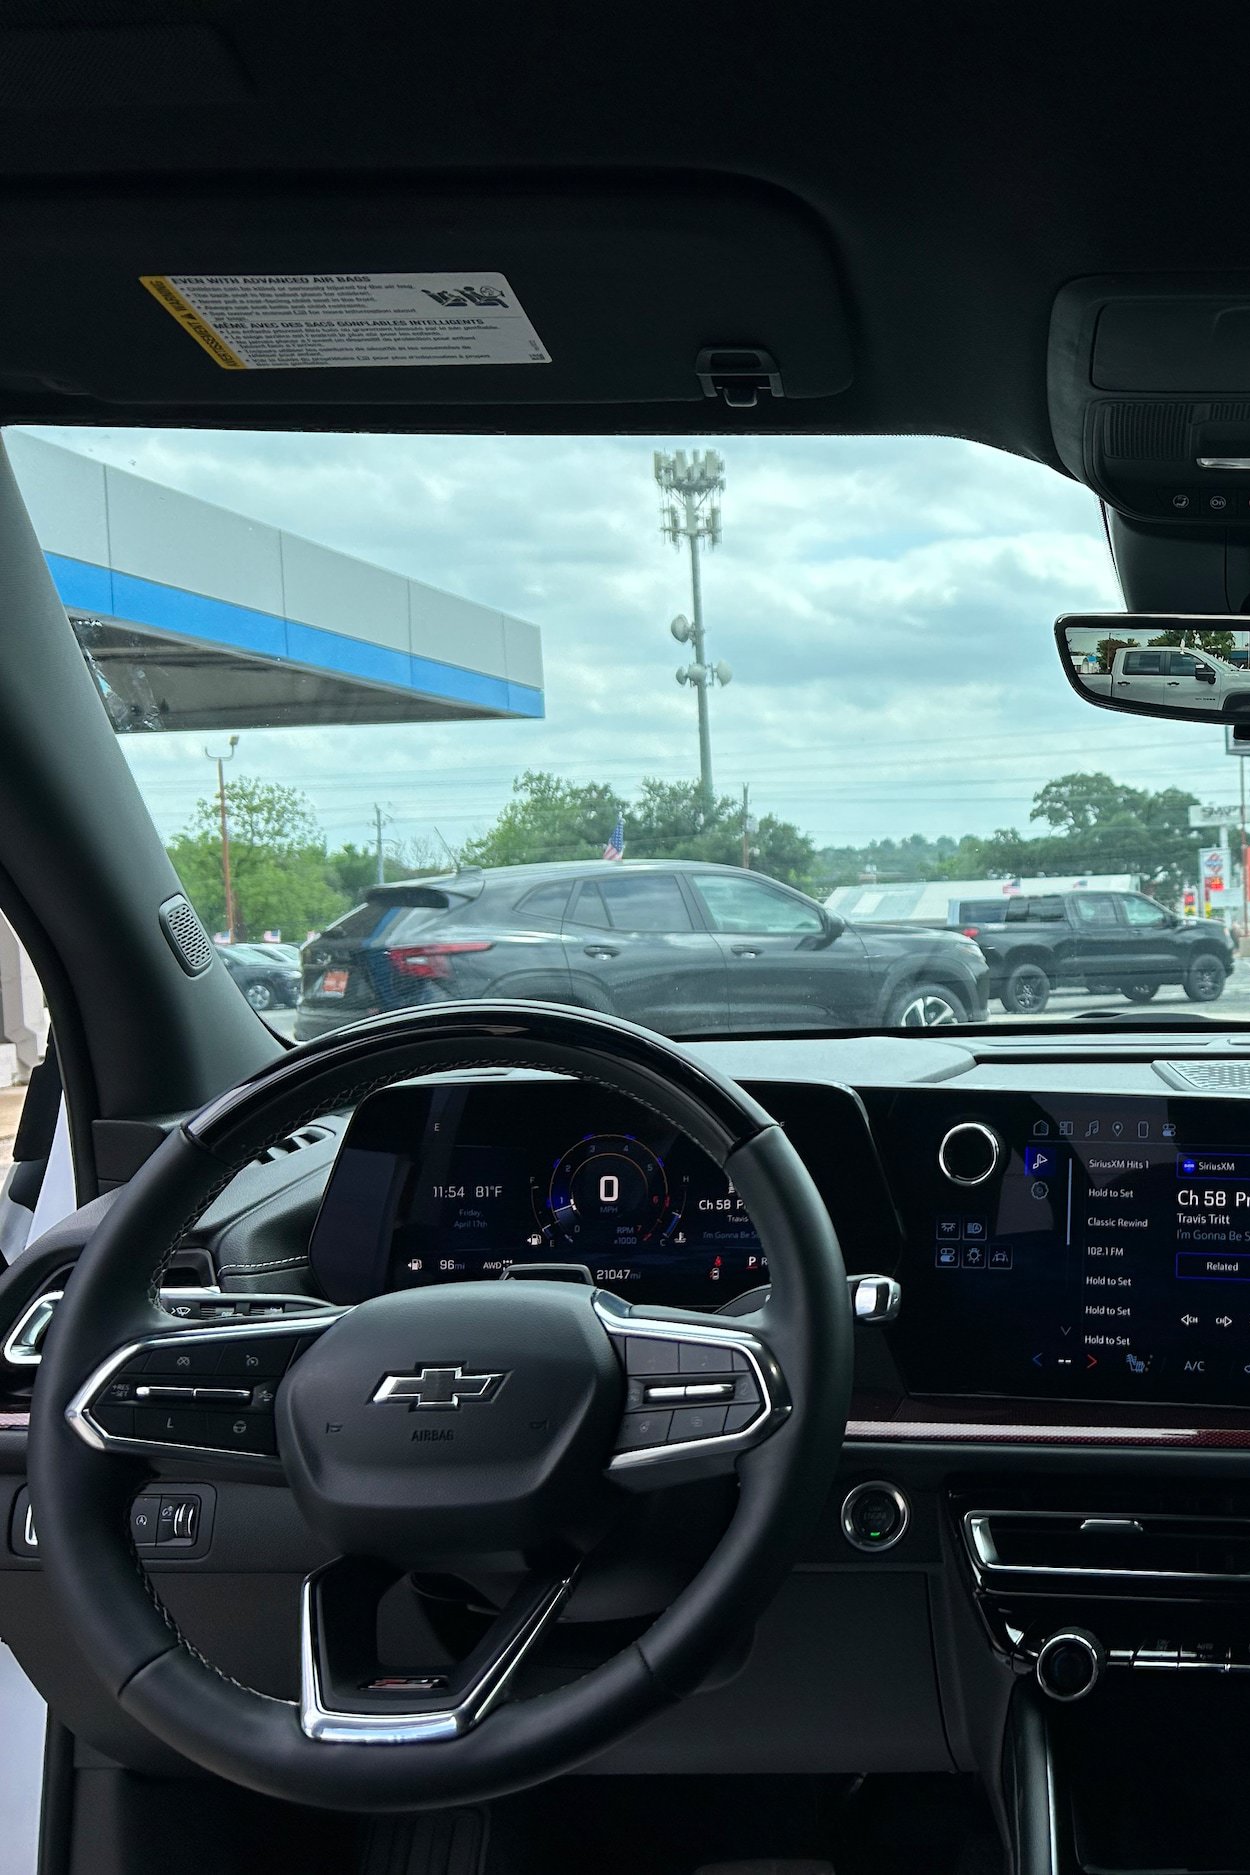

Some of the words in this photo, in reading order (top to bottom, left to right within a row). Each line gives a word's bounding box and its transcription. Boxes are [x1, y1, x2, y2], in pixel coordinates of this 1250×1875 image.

[243, 276, 309, 284] ADVANCED
[336, 275, 371, 283] BAGS
[409, 318, 485, 326] INTELLIGENTS
[1088, 1158, 1125, 1169] SiriusXM
[1126, 1159, 1143, 1169] Hits
[1198, 1161, 1235, 1171] SiriusXM
[433, 1186, 465, 1198] 11:54
[475, 1185, 503, 1198] 81°F
[599, 1175, 620, 1202] 0
[1088, 1187, 1108, 1198] Hold
[1109, 1189, 1119, 1198] to
[1119, 1188, 1134, 1199] Set
[1177, 1189, 1199, 1206] Ch
[1203, 1190, 1227, 1207] 58
[698, 1199, 713, 1210] Ch
[716, 1199, 731, 1210] 58
[727, 1214, 749, 1223] Travis
[1087, 1217, 1116, 1227] Classic
[1117, 1218, 1149, 1228] Rewind
[1177, 1212, 1206, 1224] Travis
[1208, 1213, 1230, 1225] Tritt
[453, 1219, 470, 1230] April
[471, 1219, 488, 1229] 17th
[616, 1226, 634, 1234] RPM
[1176, 1229, 1191, 1240] I'm
[1193, 1230, 1227, 1241] Gonna
[1229, 1230, 1243, 1242] Be
[1087, 1246, 1109, 1256] 102.1
[1110, 1247, 1124, 1257] FM
[482, 1262, 502, 1270] AWD
[748, 1256, 757, 1266] P
[1206, 1261, 1239, 1272] Related
[1086, 1276, 1106, 1286] Hold
[1107, 1277, 1117, 1286] to
[1117, 1276, 1132, 1287] Set
[1085, 1305, 1105, 1316] Hold
[1106, 1306, 1116, 1316] to
[1117, 1306, 1131, 1317] Set
[1084, 1335, 1104, 1345] Hold
[1105, 1336, 1115, 1345] to
[1116, 1336, 1130, 1346] Set
[1184, 1361, 1206, 1372] A/C
[411, 1430, 454, 1442] AIRBAG
